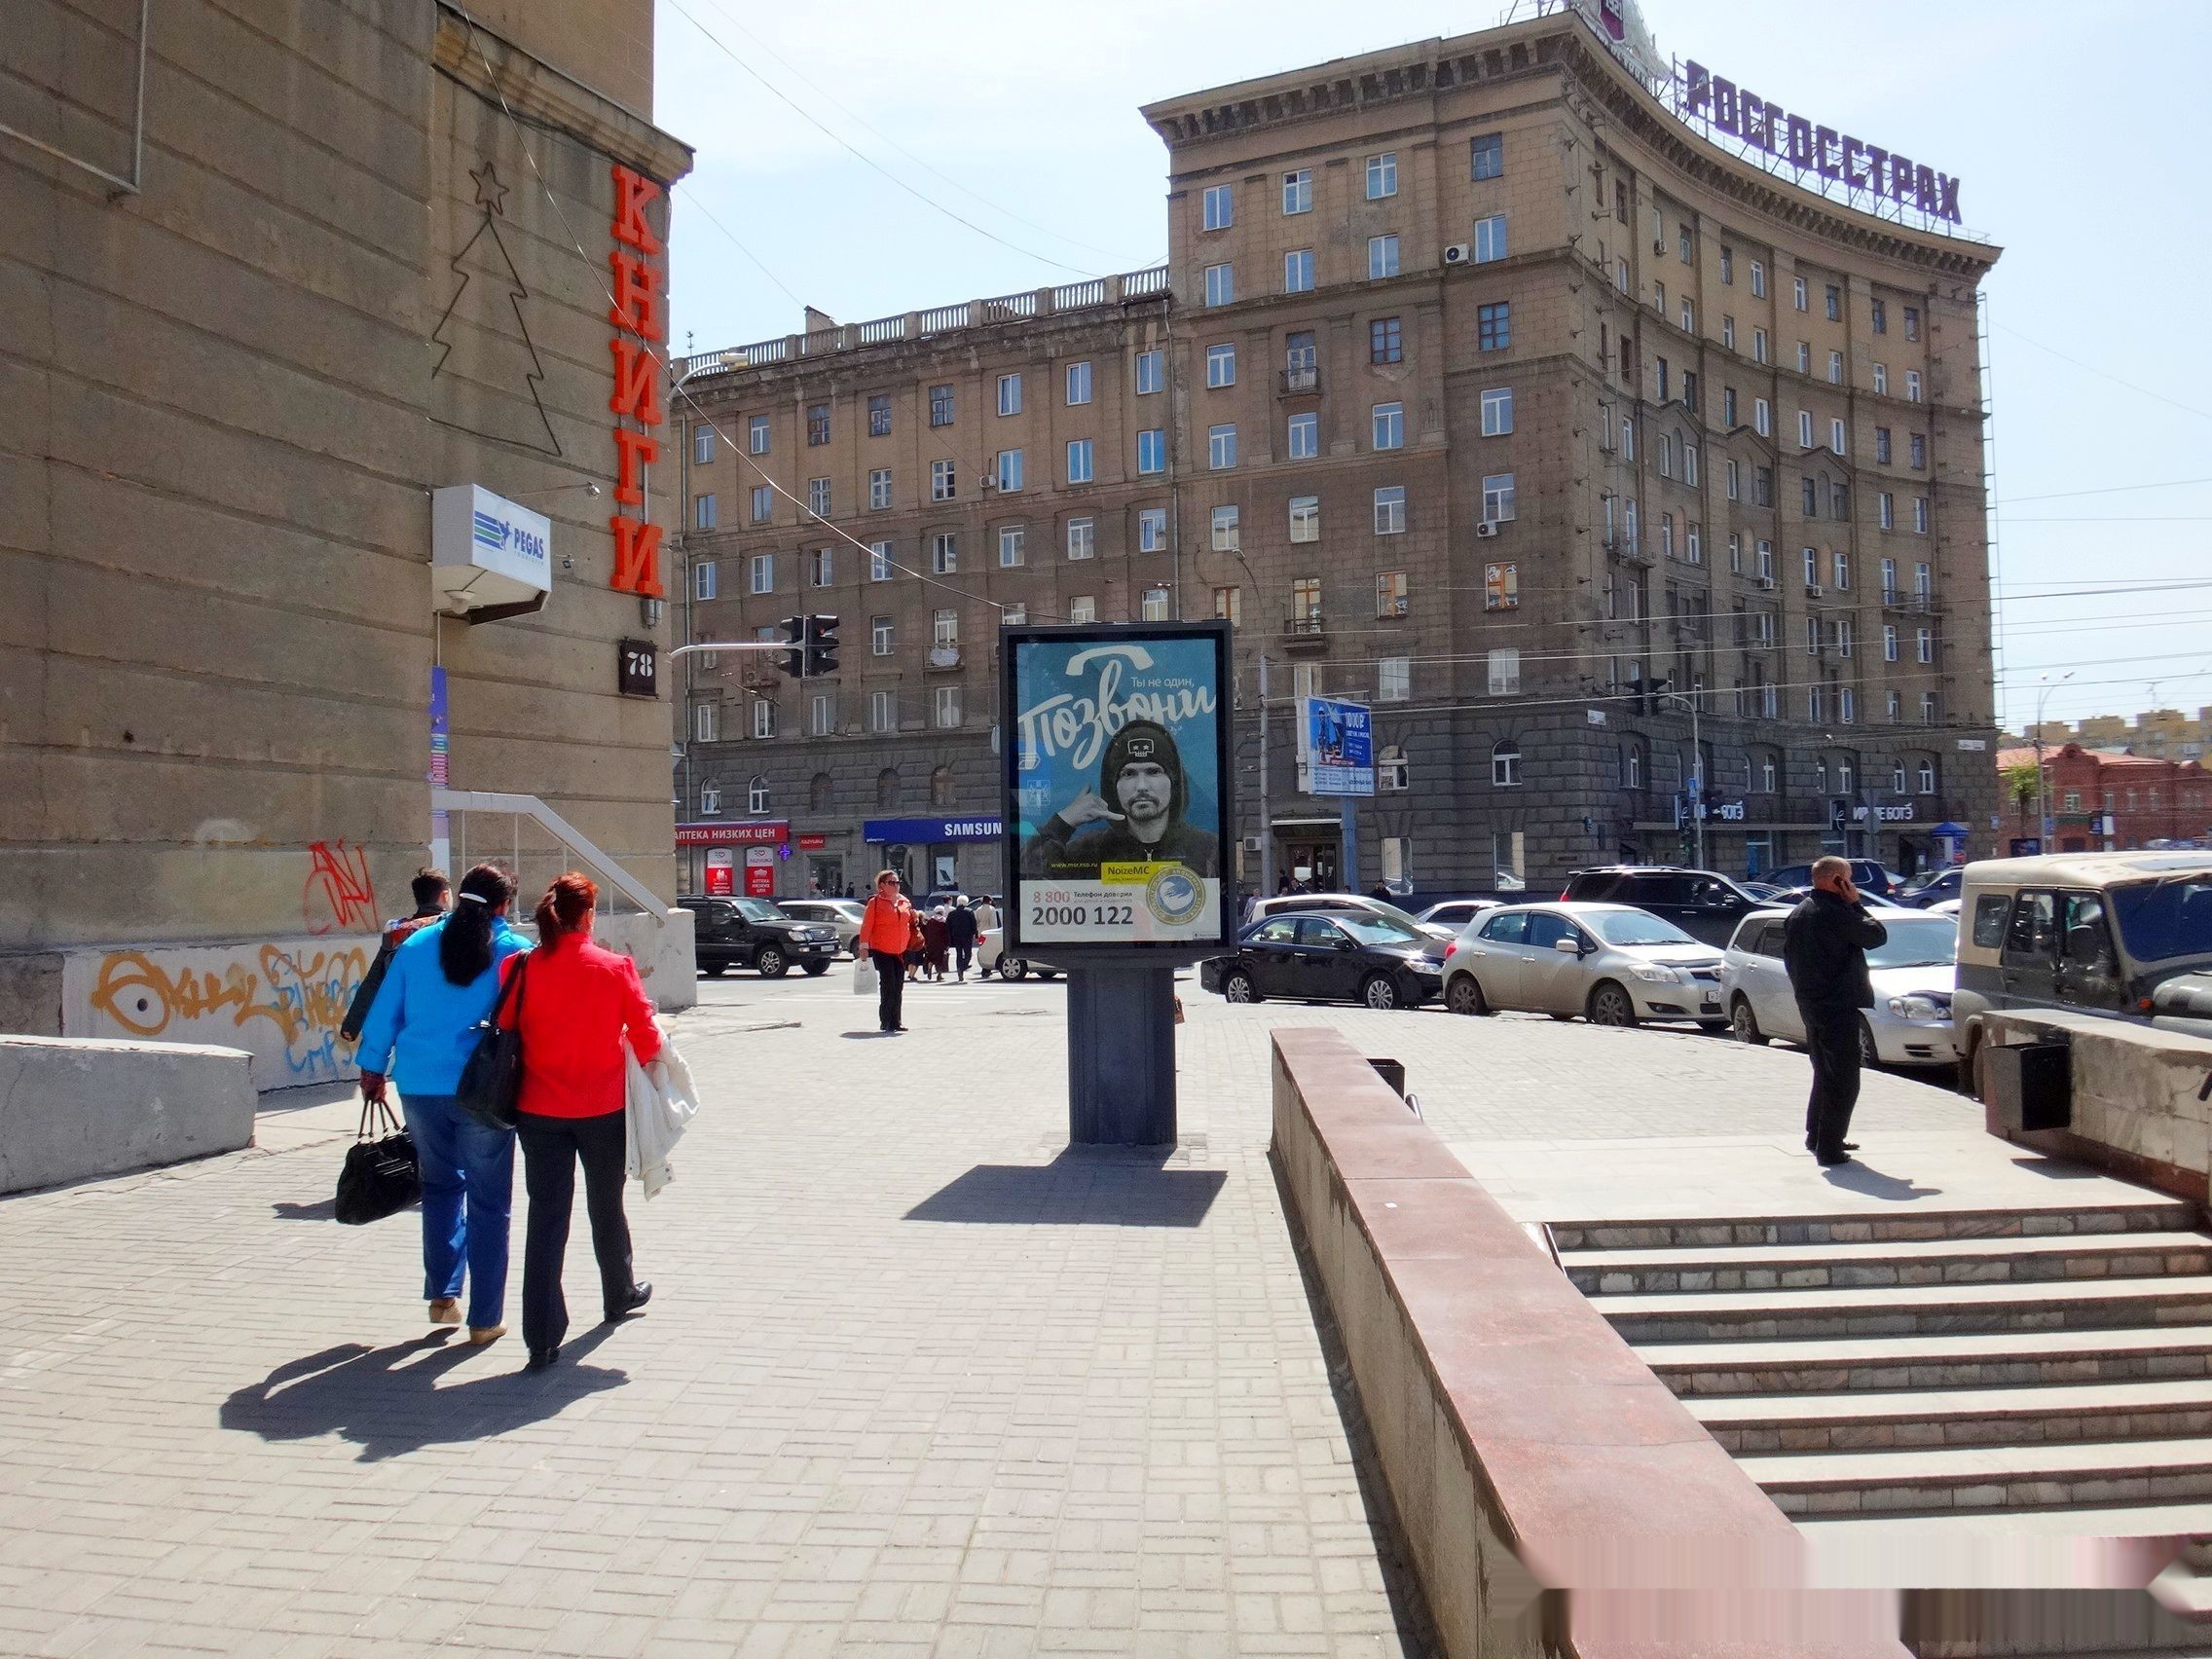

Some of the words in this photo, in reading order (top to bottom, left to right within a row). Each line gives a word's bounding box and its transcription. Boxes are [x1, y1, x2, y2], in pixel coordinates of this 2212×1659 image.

[1686, 58, 1962, 225] РОСГОССТРАХ
[609, 164, 663, 599] КНИГИ
[514, 527, 544, 560] PEGAS
[627, 651, 653, 677] 78
[1130, 676, 1146, 688] Ты
[1148, 678, 1161, 687] не
[1016, 659, 1217, 770] Позвони
[674, 830, 709, 840] АПТЕКА
[712, 829, 752, 839] НИЗКИХ
[755, 829, 775, 840] ЦЕН
[944, 822, 1002, 836] SAMSUN
[1107, 866, 1150, 875] NoizeMC
[1033, 891, 1042, 903] 8
[1045, 891, 1070, 903] 800
[1032, 906, 1087, 925] 2000
[1093, 905, 1134, 925] 122
